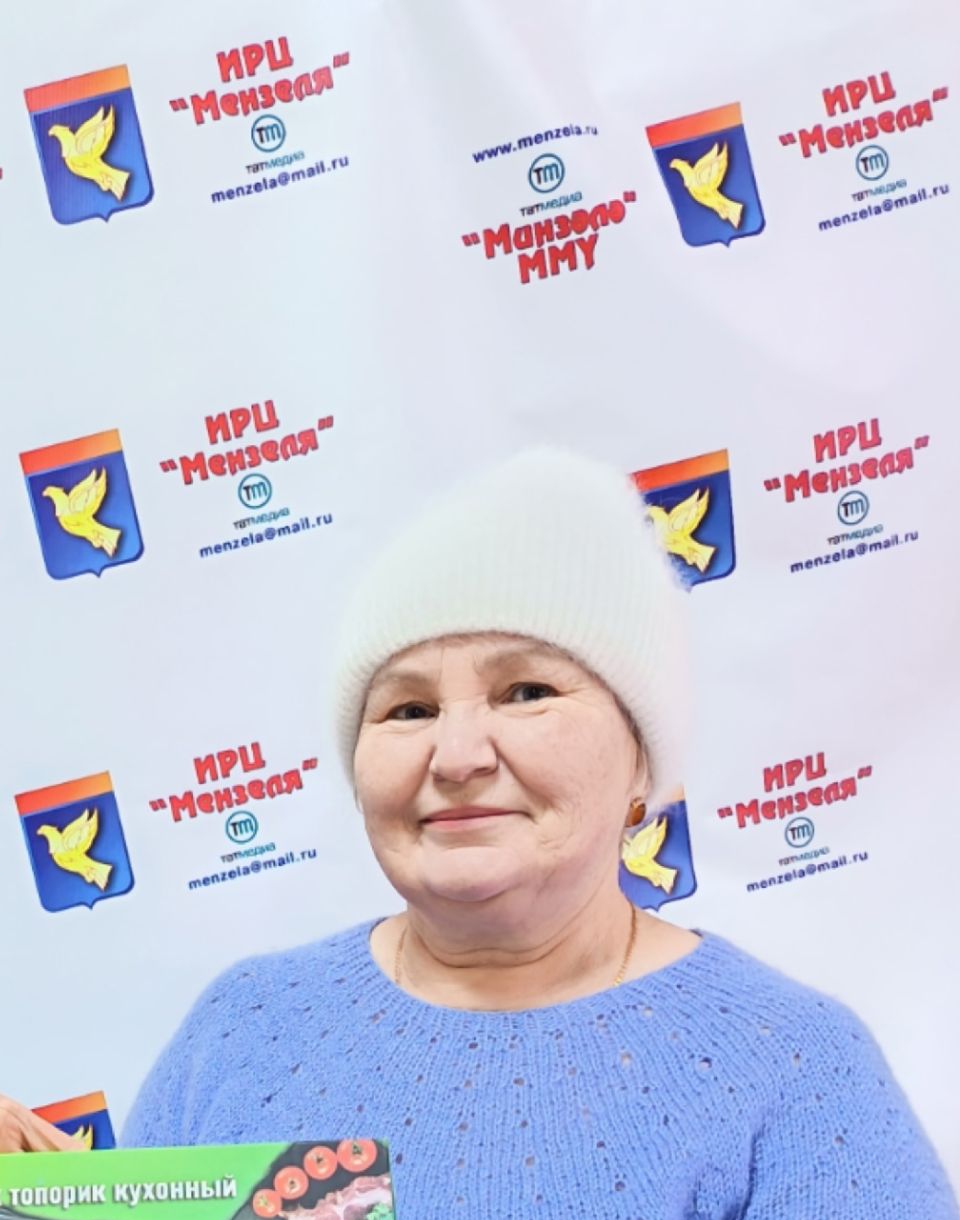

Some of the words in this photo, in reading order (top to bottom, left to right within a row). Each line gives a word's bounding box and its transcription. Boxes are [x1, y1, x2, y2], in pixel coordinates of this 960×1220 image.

[216, 36, 293, 83] ИРЦ
[822, 71, 896, 117] ИРЦ
[472, 124, 597, 163] www.menzela.ru
[211, 156, 349, 203] menzela@mail.ru
[818, 184, 949, 231] menzela@mail.ru
[205, 400, 280, 445] ИРЦ
[813, 418, 882, 463] ИРЦ
[199, 513, 333, 558] menzela@mail.ru
[790, 531, 919, 573] menzela@mail.ru
[194, 742, 266, 784] ИРЦ
[763, 751, 827, 793] ИРЦ
[188, 848, 317, 890] menzela@mail.ru
[747, 851, 869, 892] menzela@mail.ru
[9, 1184, 106, 1210] топорик
[114, 1175, 237, 1206] кухонный
